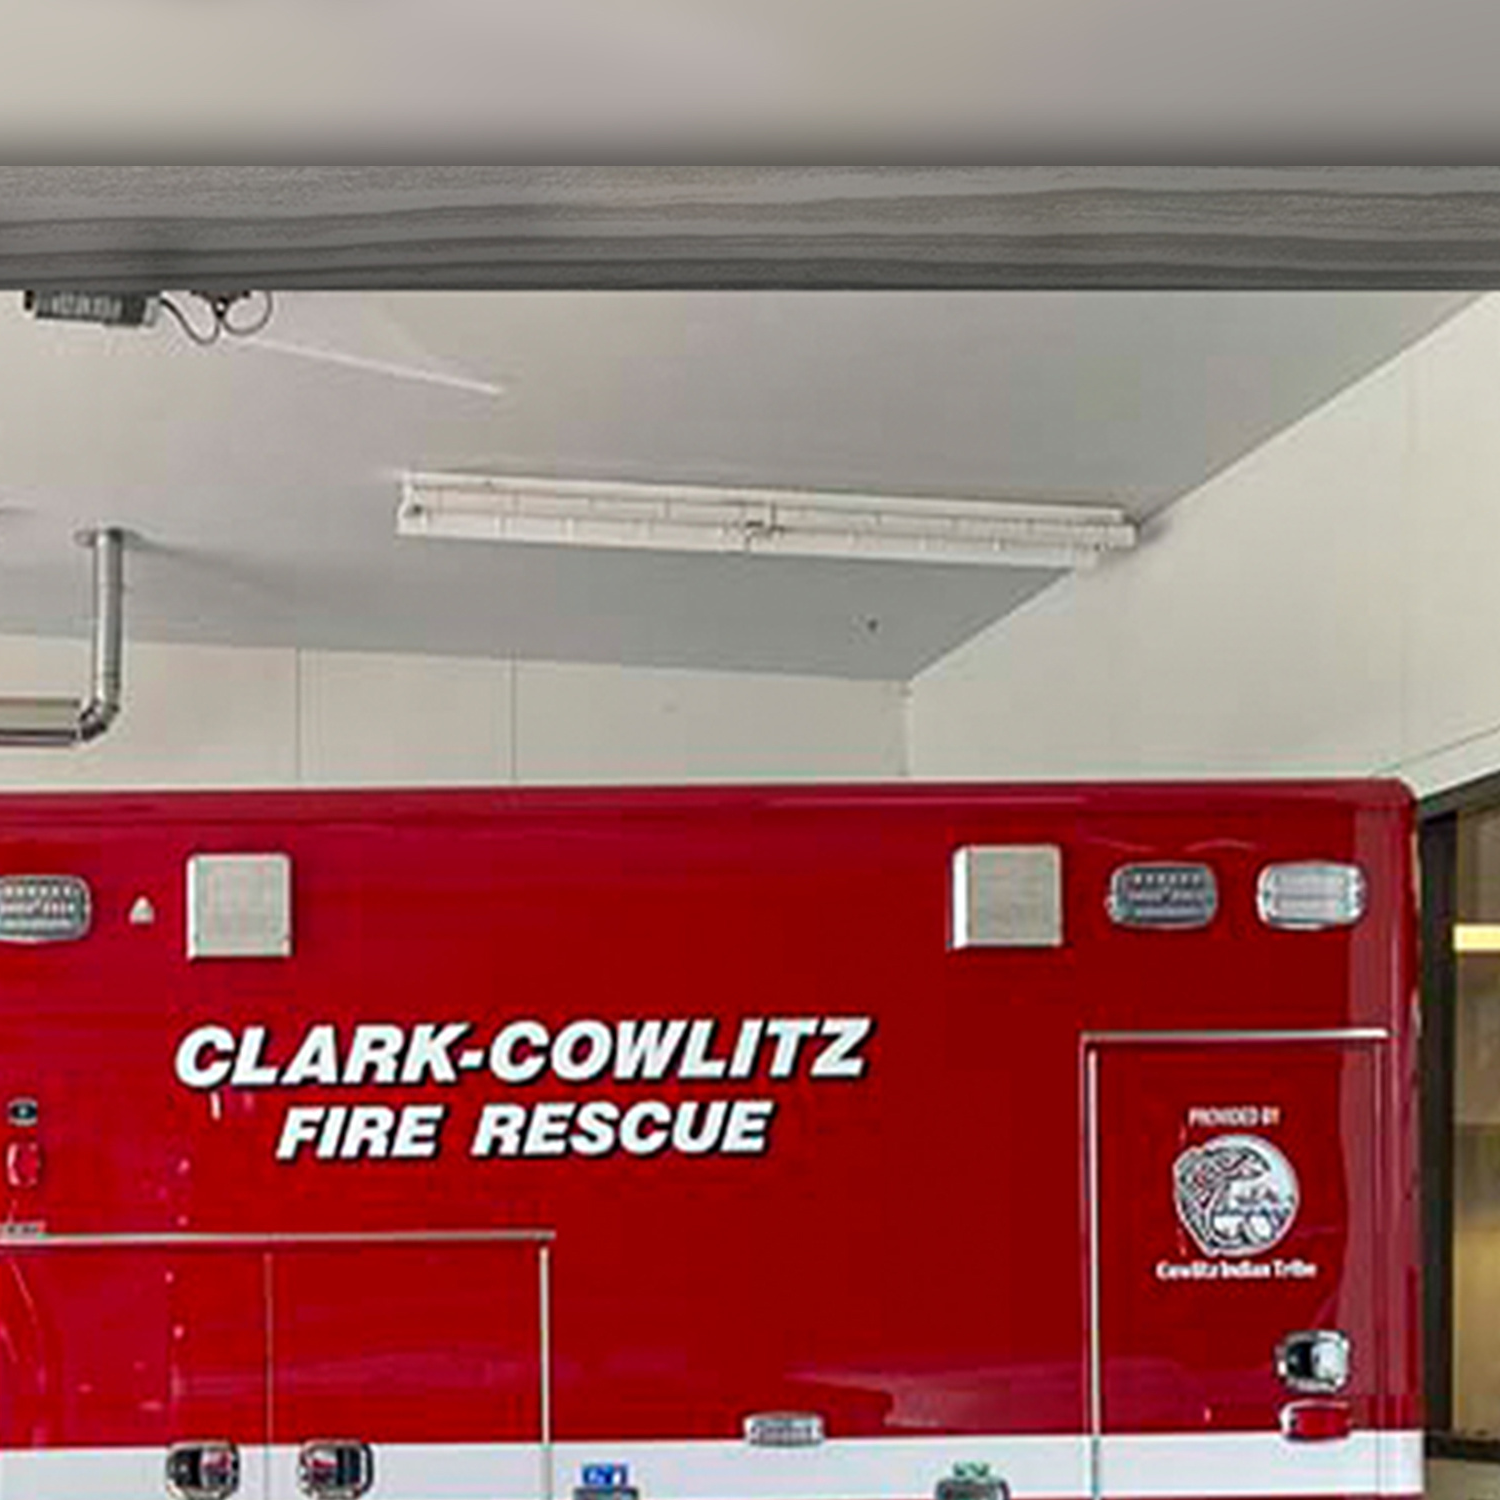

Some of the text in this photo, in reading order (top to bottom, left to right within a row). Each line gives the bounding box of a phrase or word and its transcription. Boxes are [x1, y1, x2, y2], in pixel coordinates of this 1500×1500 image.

[175, 1017, 871, 1087] CLARK-COWLITZ
[276, 1100, 773, 1159] FIRE RESCUE
